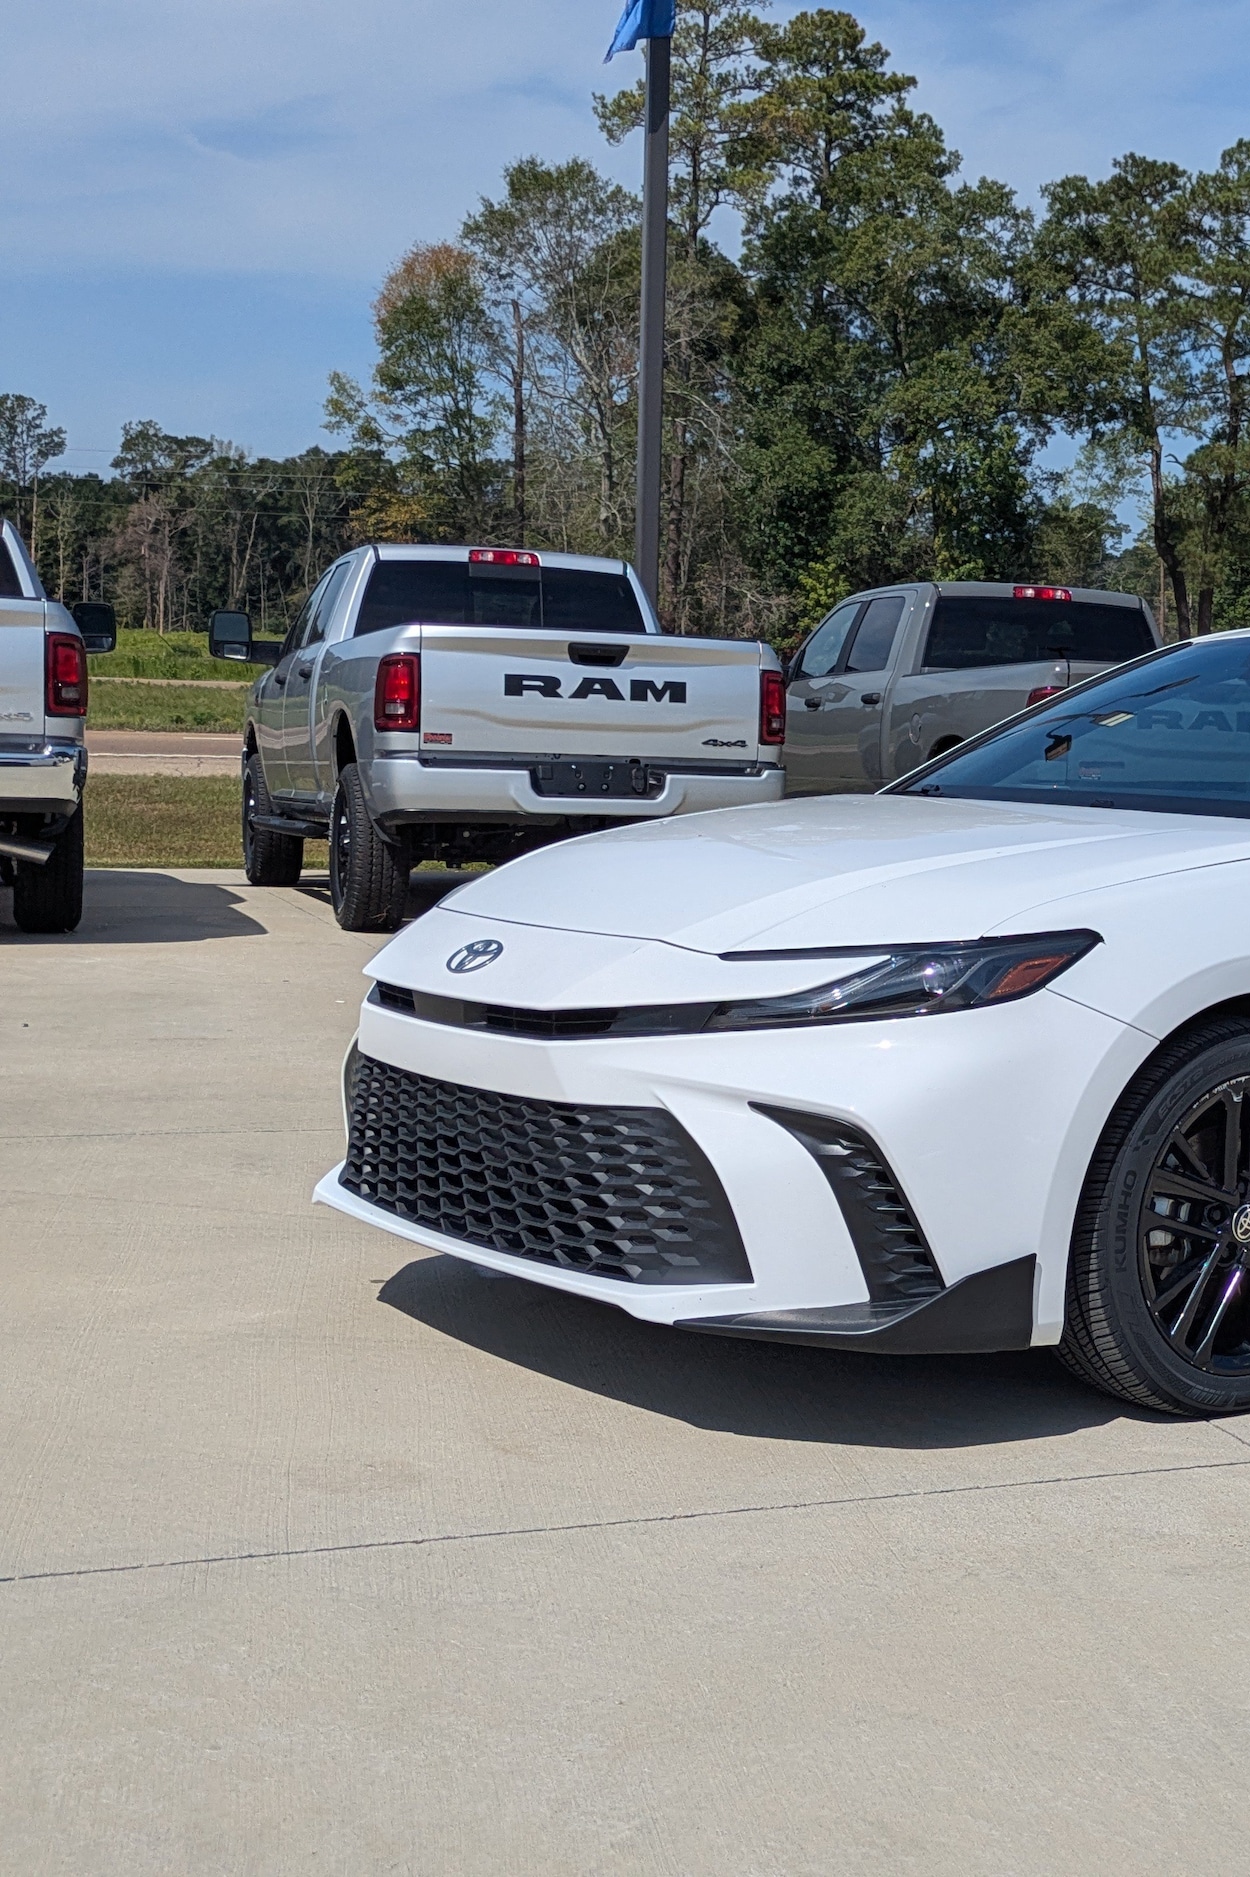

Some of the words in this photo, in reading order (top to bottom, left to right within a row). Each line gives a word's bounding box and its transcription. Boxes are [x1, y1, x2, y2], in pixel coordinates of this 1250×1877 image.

[504, 674, 687, 704] RAM
[701, 739, 749, 748] 4x4
[1114, 1169, 1138, 1274] KUMHO
